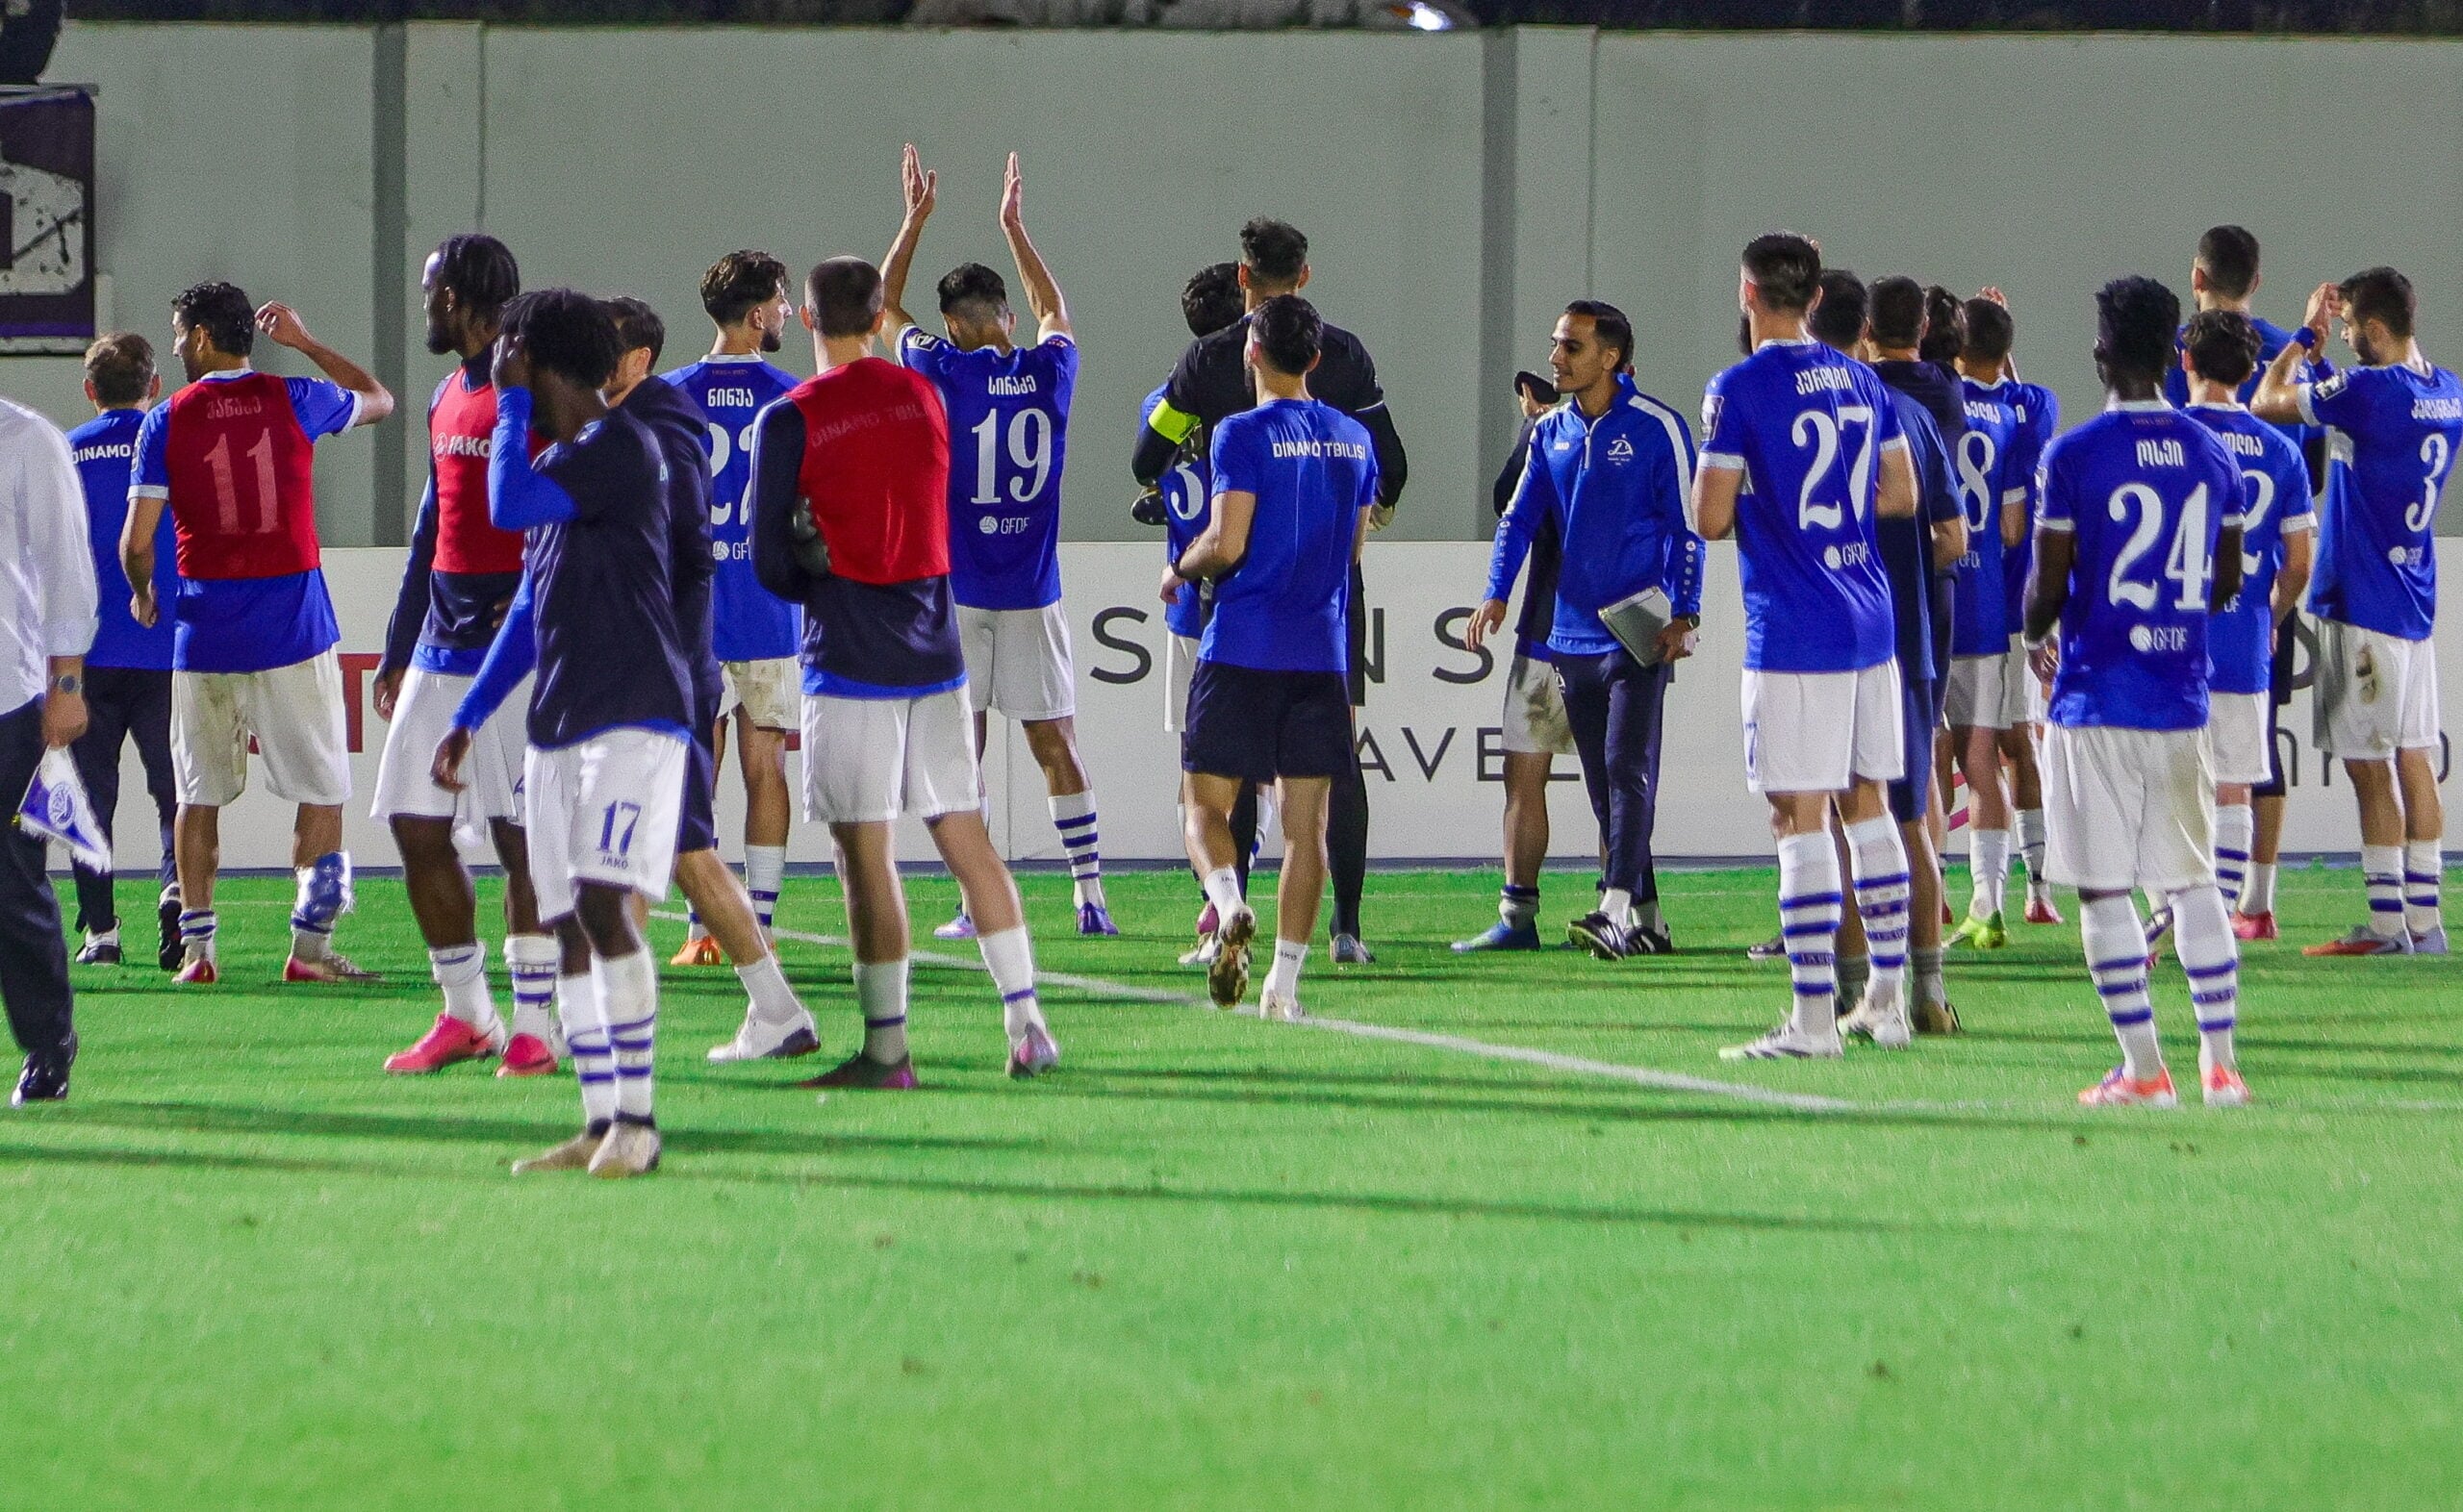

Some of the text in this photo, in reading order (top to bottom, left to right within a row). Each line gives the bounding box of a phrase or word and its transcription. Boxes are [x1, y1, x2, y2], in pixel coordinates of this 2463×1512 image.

[707, 388, 754, 407] ნინუა
[203, 427, 280, 535] 11
[970, 408, 1052, 504] 19
[1273, 441, 1366, 461] DINAMO TBILISI
[1791, 405, 1874, 530] 27
[1957, 430, 1995, 532] 8
[2136, 439, 2185, 467] ოსეი
[2404, 433, 2449, 532] 3
[1001, 517, 1030, 535] GFDF
[2108, 482, 2213, 611] 24
[595, 800, 642, 857] 17
